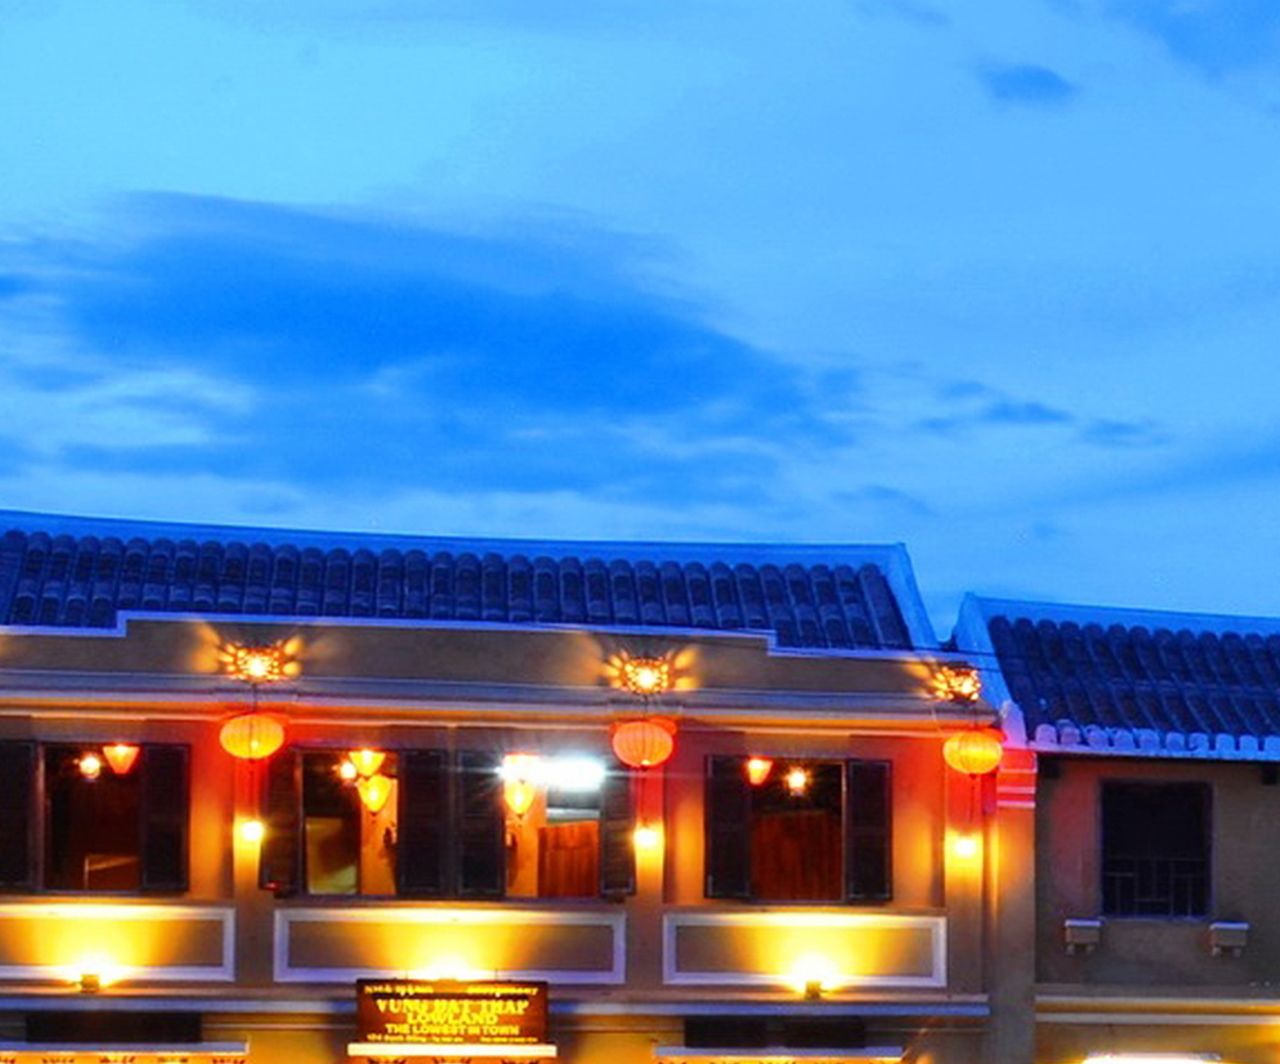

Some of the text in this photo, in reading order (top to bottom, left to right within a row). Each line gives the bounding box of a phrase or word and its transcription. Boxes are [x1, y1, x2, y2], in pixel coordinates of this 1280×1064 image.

[407, 1012, 498, 1025] LOWLAND
[385, 1024, 410, 1034] THE
[412, 1024, 466, 1035] LOWEST
[482, 1025, 519, 1035] TOWN
